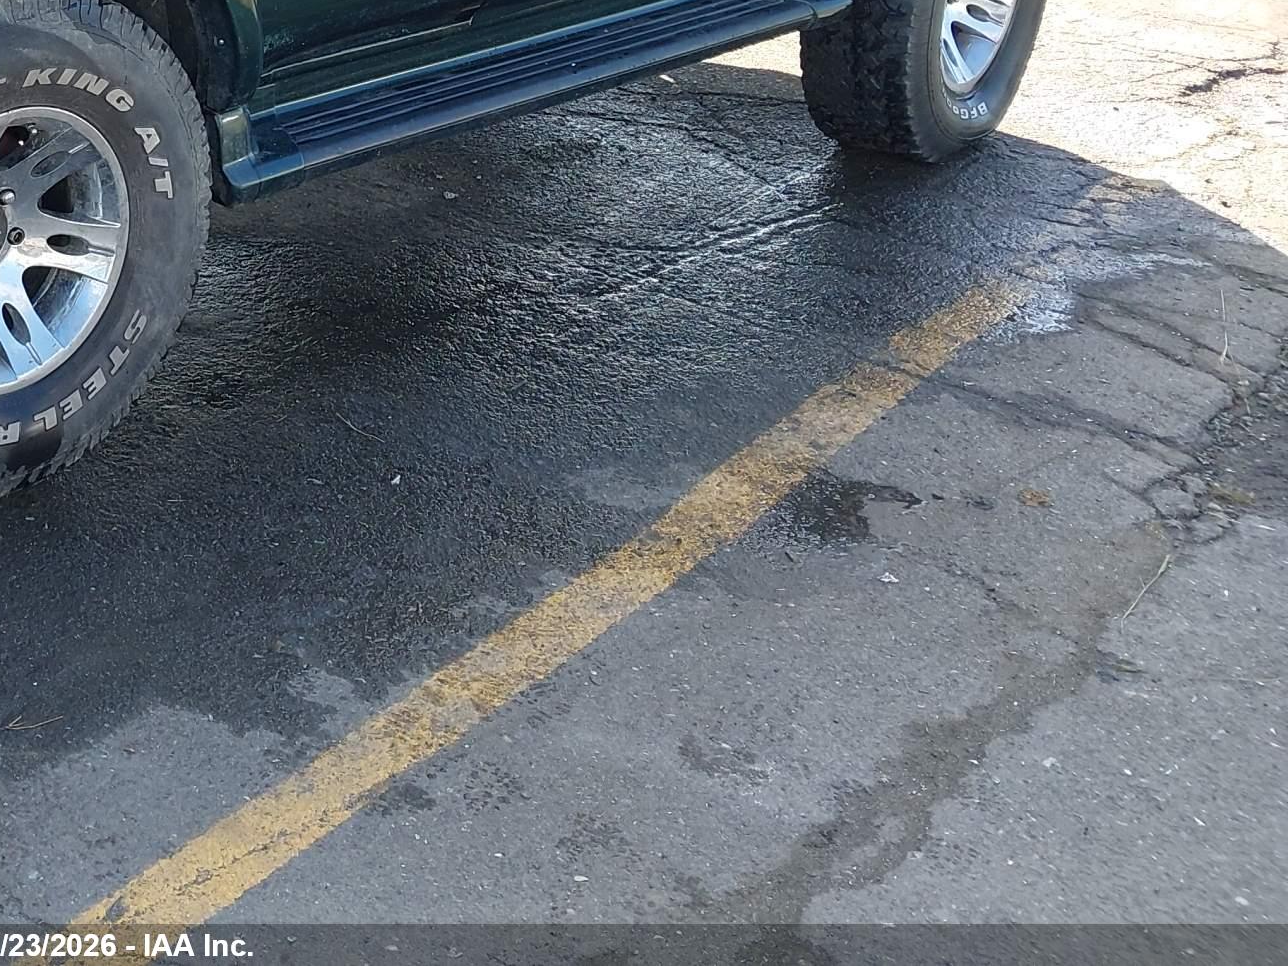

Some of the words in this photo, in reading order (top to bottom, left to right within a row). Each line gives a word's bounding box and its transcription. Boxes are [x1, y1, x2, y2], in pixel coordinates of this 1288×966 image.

[21, 67, 135, 112] KING
[134, 127, 174, 199] A/T
[33, 308, 148, 431] STEEL
